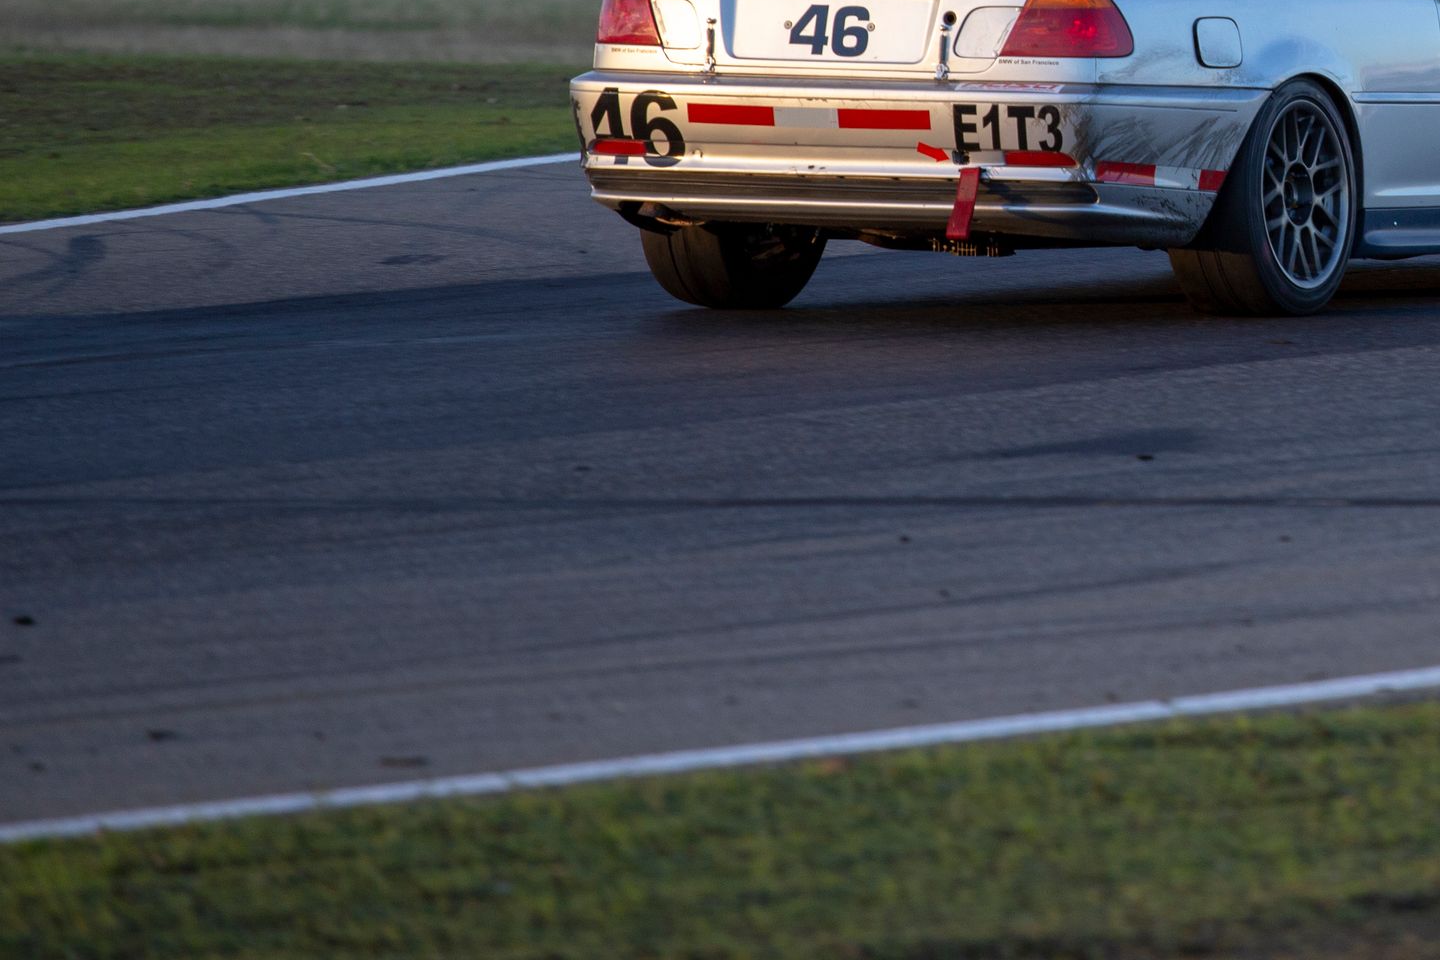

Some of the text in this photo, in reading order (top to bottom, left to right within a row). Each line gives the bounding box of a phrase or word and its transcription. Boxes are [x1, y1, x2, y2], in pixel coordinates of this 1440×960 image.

[789, 4, 870, 57] 46
[591, 87, 685, 167] 46
[953, 104, 1063, 151] E1T3
